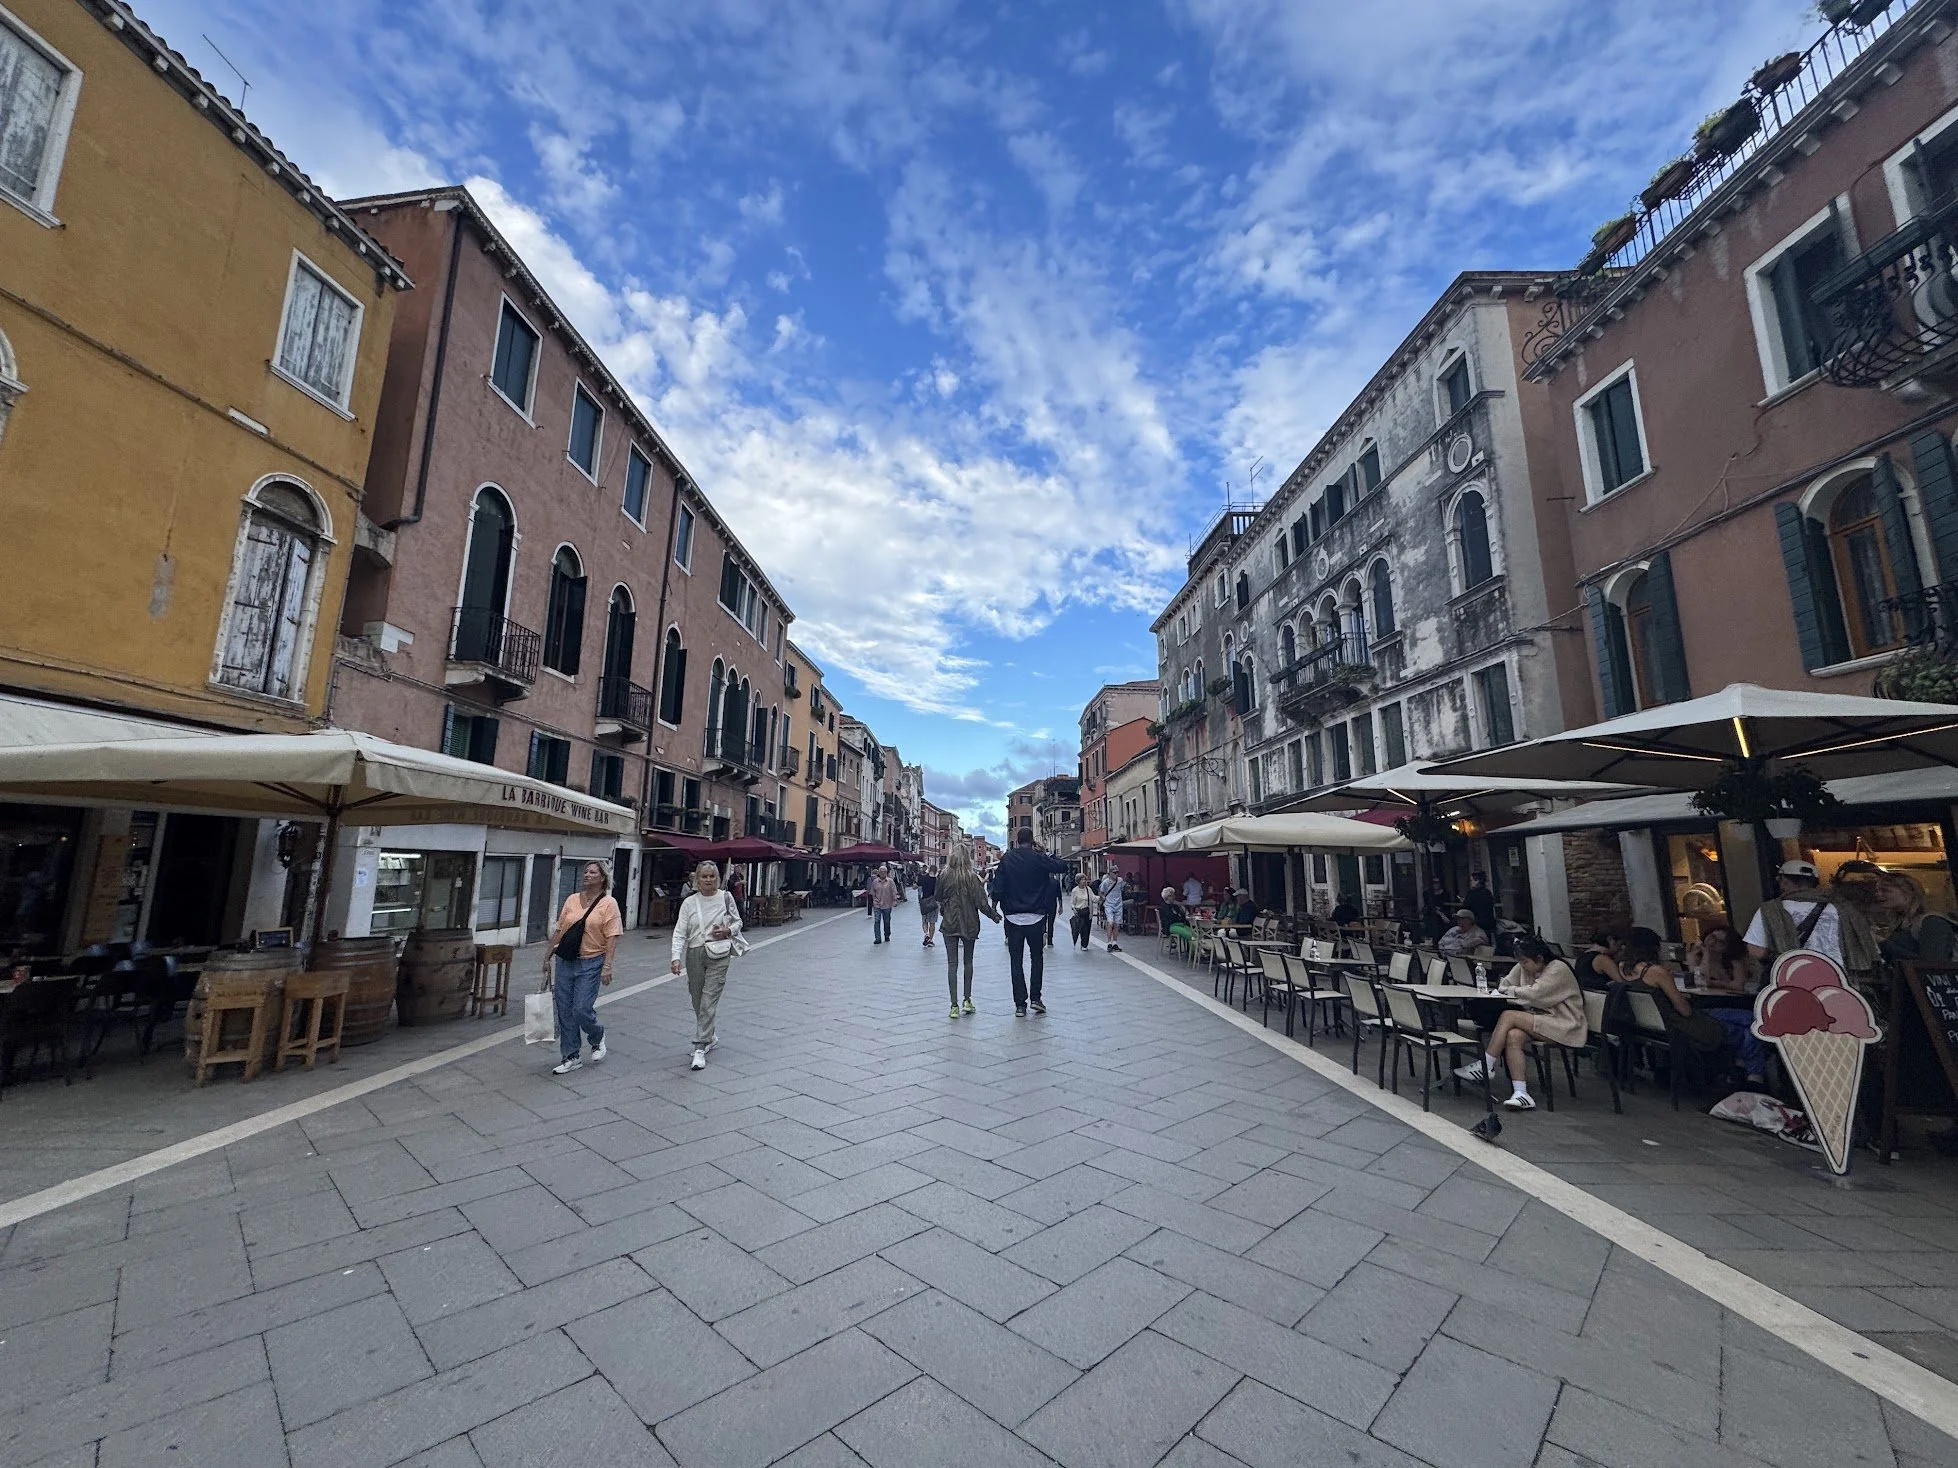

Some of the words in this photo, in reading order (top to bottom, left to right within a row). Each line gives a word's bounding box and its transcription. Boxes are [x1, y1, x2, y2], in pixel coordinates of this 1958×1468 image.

[502, 785, 516, 801] LA
[571, 803, 592, 821] WINE
[594, 809, 609, 825] BAR
